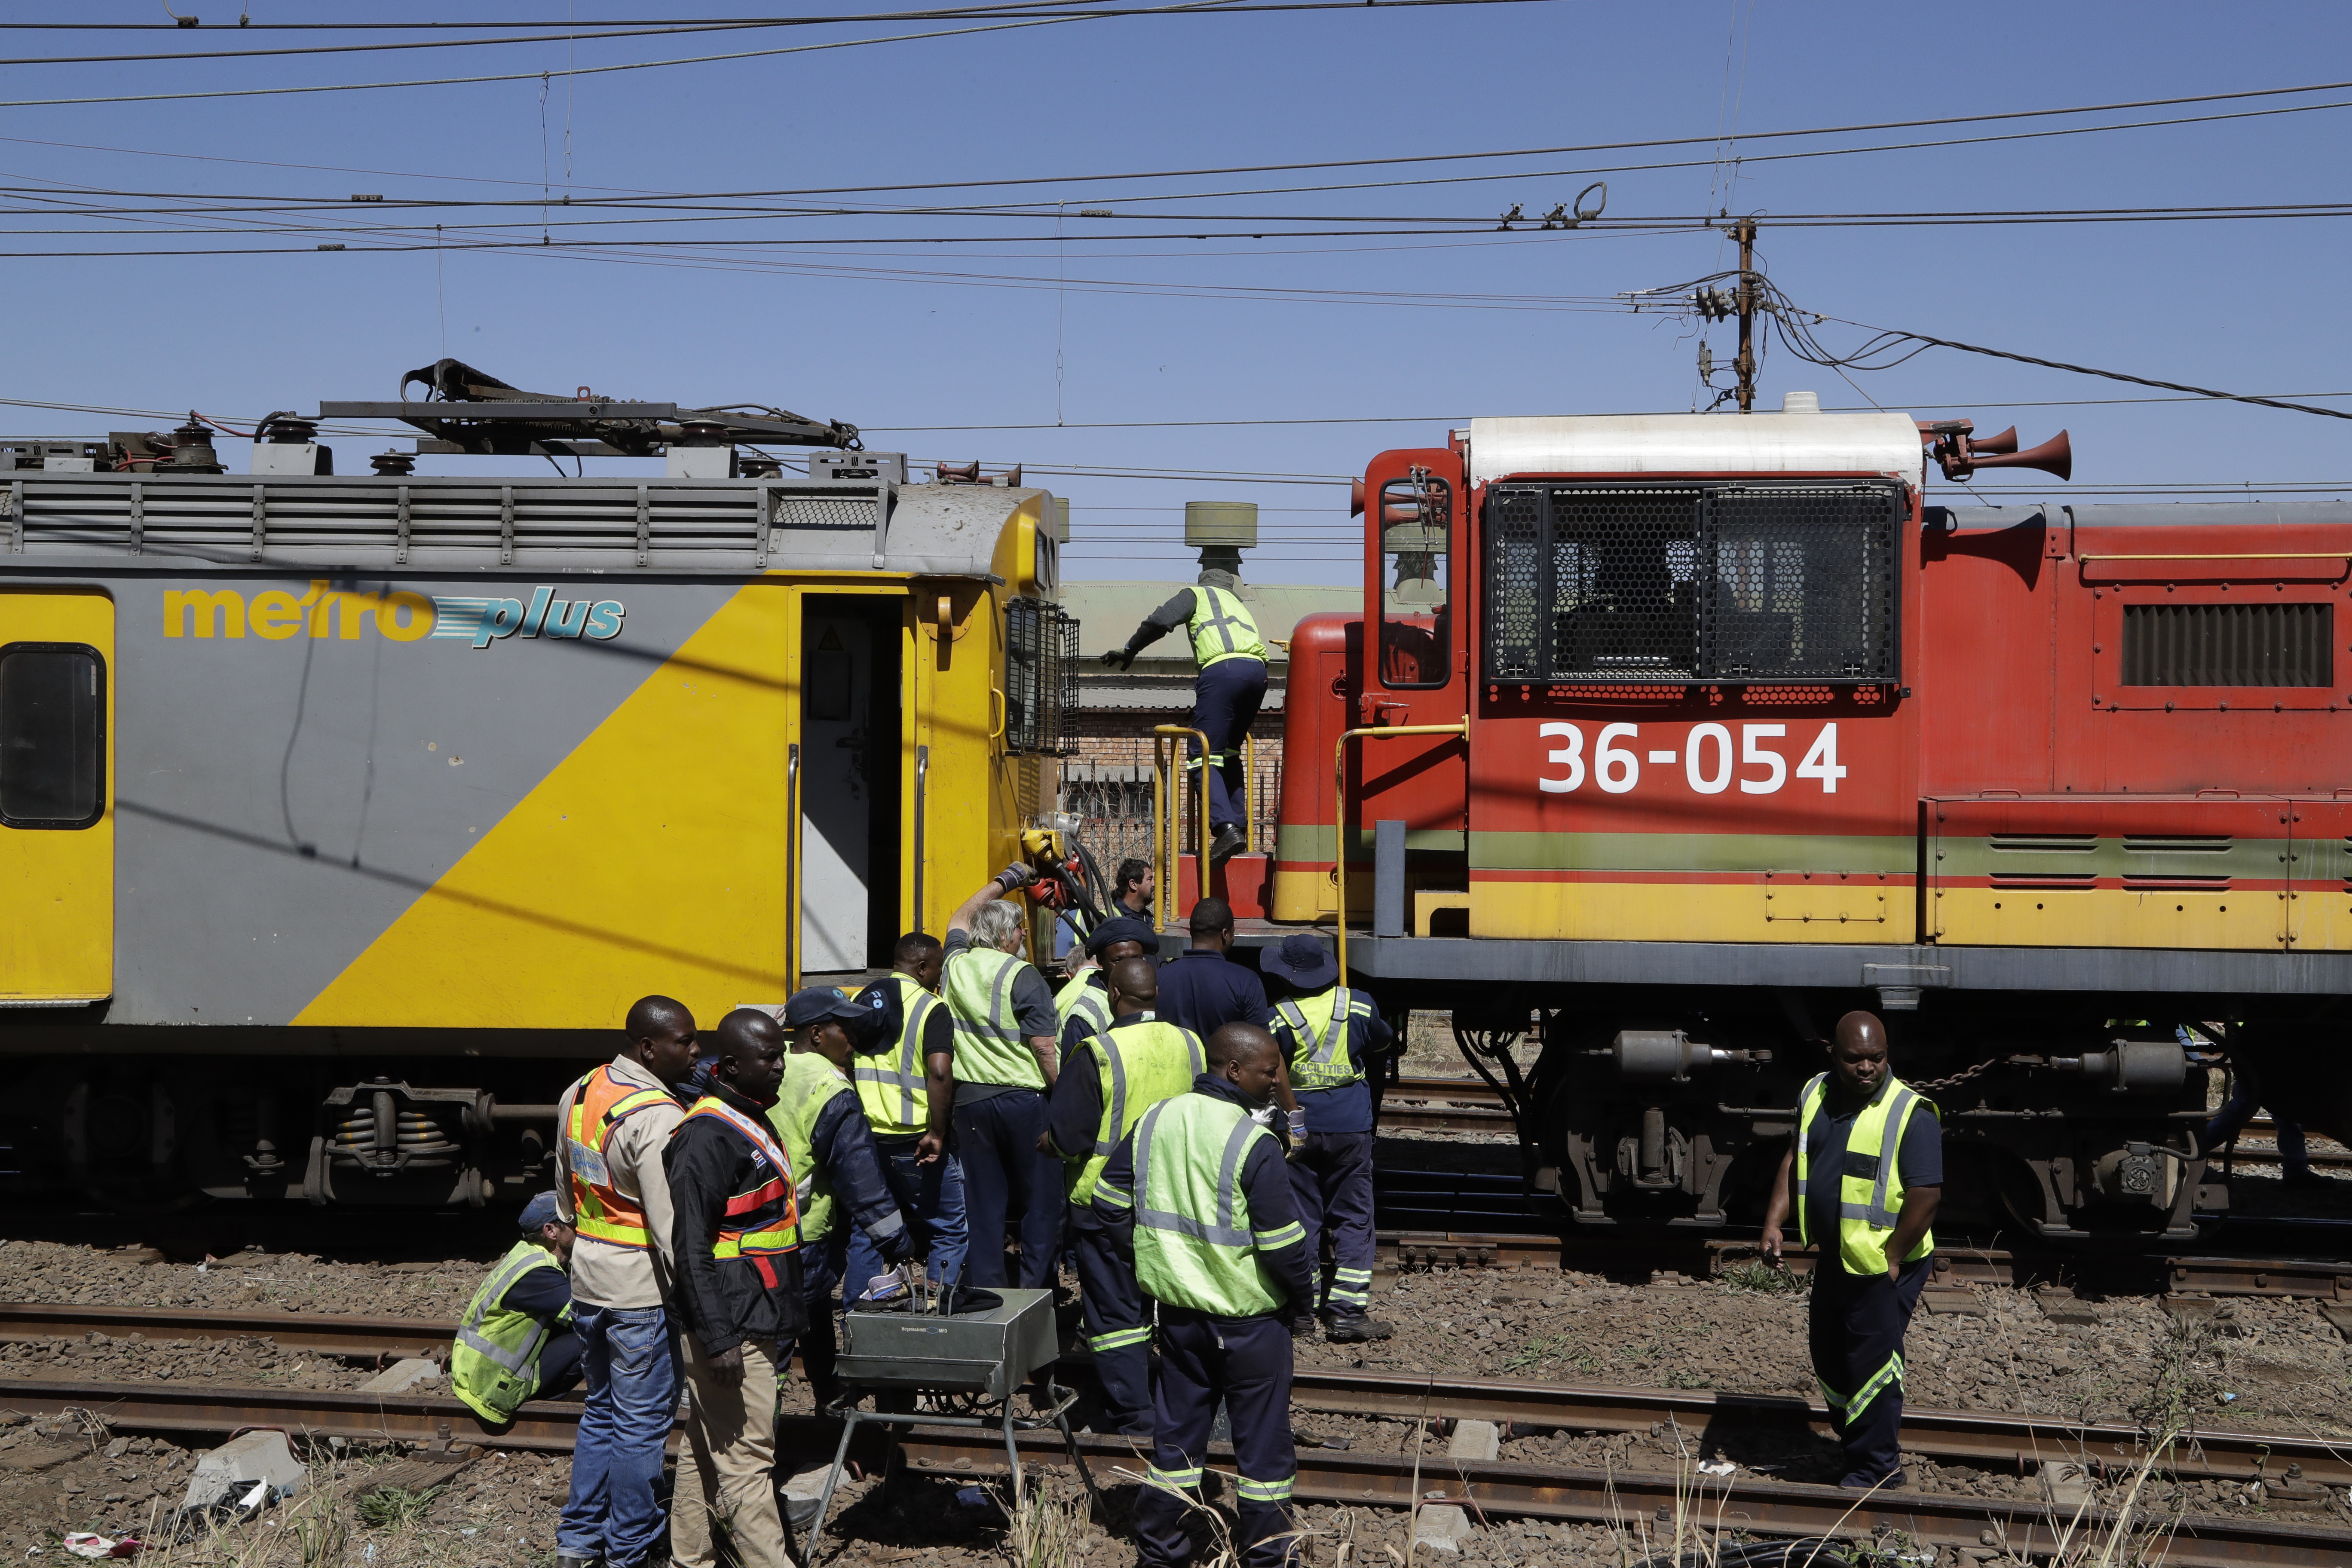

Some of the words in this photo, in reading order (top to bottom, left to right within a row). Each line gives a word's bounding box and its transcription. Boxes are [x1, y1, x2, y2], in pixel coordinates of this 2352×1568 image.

[164, 579, 433, 642] metro
[471, 585, 628, 650] plus
[1539, 722, 1847, 794] 36-054
[1295, 1063, 1351, 1075] FACILITIES
